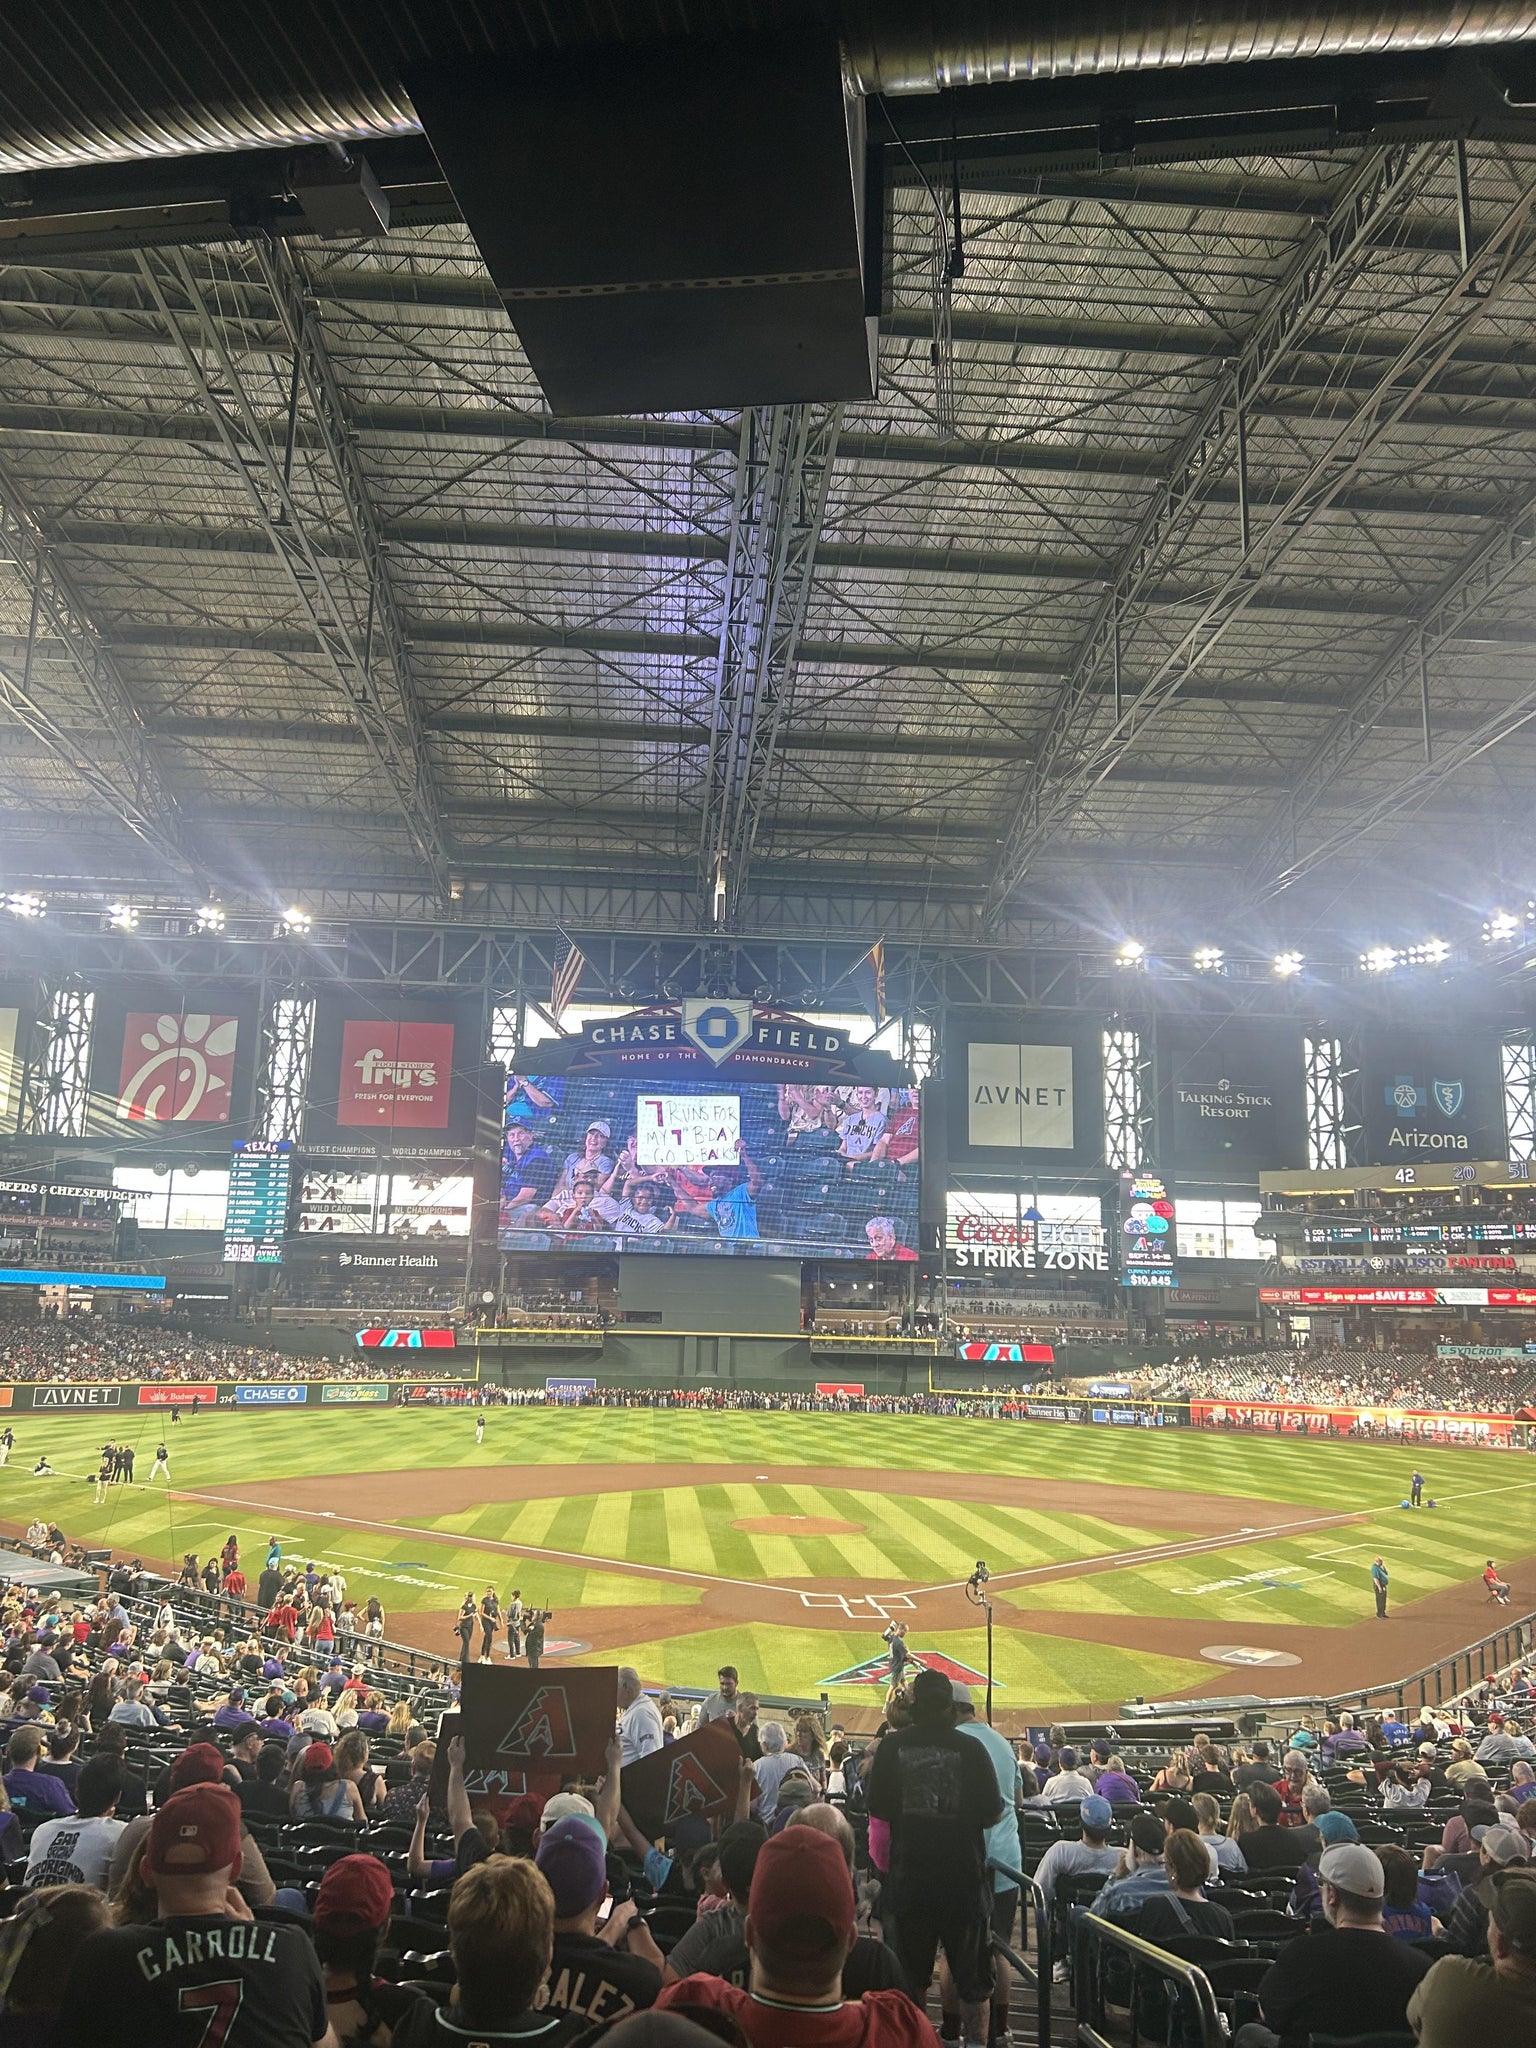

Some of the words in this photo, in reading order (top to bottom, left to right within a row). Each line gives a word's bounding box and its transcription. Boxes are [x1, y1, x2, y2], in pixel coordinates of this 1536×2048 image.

[592, 1024, 675, 1044] CHASE
[758, 1029, 840, 1052] FIELD
[621, 1053, 650, 1061] HOME
[735, 1054, 810, 1068] DIAMONDBACKS
[354, 1049, 436, 1088] fry's
[396, 1094, 434, 1102] EVERYONE
[974, 1085, 1066, 1106] AVNET
[1177, 1091, 1233, 1104] TALKING
[1237, 1092, 1272, 1106] STICK
[645, 1101, 664, 1127] 7
[666, 1100, 709, 1124] RUNS
[714, 1105, 738, 1121] FOR
[1200, 1104, 1251, 1118] RESORT
[647, 1129, 667, 1146] MY
[693, 1125, 738, 1145] B-DAY
[1388, 1127, 1468, 1149] Arizona
[244, 1141, 278, 1153] TEXAS
[308, 1145, 330, 1153] WEST
[332, 1146, 376, 1155] CHAMPIONS
[392, 1147, 417, 1155] WORLD
[418, 1148, 462, 1156] CHAMPIONS
[653, 1148, 675, 1163] GO
[1395, 1168, 1416, 1183] 42
[1452, 1165, 1475, 1181] 20
[1508, 1162, 1529, 1179] 51
[0, 1181, 37, 1193] BEERS
[39, 1184, 48, 1194] &
[50, 1185, 151, 1200] CHEESEBURGERS
[331, 1205, 352, 1213] CARD
[406, 1206, 453, 1215] CHAMPIONS
[956, 1214, 1031, 1243] Coors
[353, 1254, 396, 1266] Banner
[399, 1255, 438, 1267] Health
[955, 1248, 1036, 1268] STRIKE
[1044, 1251, 1109, 1271] ZONE
[1301, 1257, 1371, 1269] ESTRELLA
[1387, 1257, 1446, 1269] JALISCO
[1447, 1256, 1516, 1268] CANTINA
[1130, 1274, 1171, 1286] $10,845
[1324, 1291, 1343, 1302] Sign
[1344, 1292, 1356, 1302] up
[1357, 1291, 1375, 1300] and
[1376, 1291, 1406, 1301] SAVE
[43, 1388, 111, 1403] AVNET
[170, 1392, 207, 1401] Budweser
[243, 1389, 285, 1400] CHASE
[1164, 1415, 1177, 1424] 374
[1236, 1406, 1282, 1425] State
[1283, 1411, 1328, 1428] Farm
[136, 1925, 277, 1981] CARROLL
[549, 1967, 636, 2025] ALEZ
[178, 1977, 244, 2048] 7
